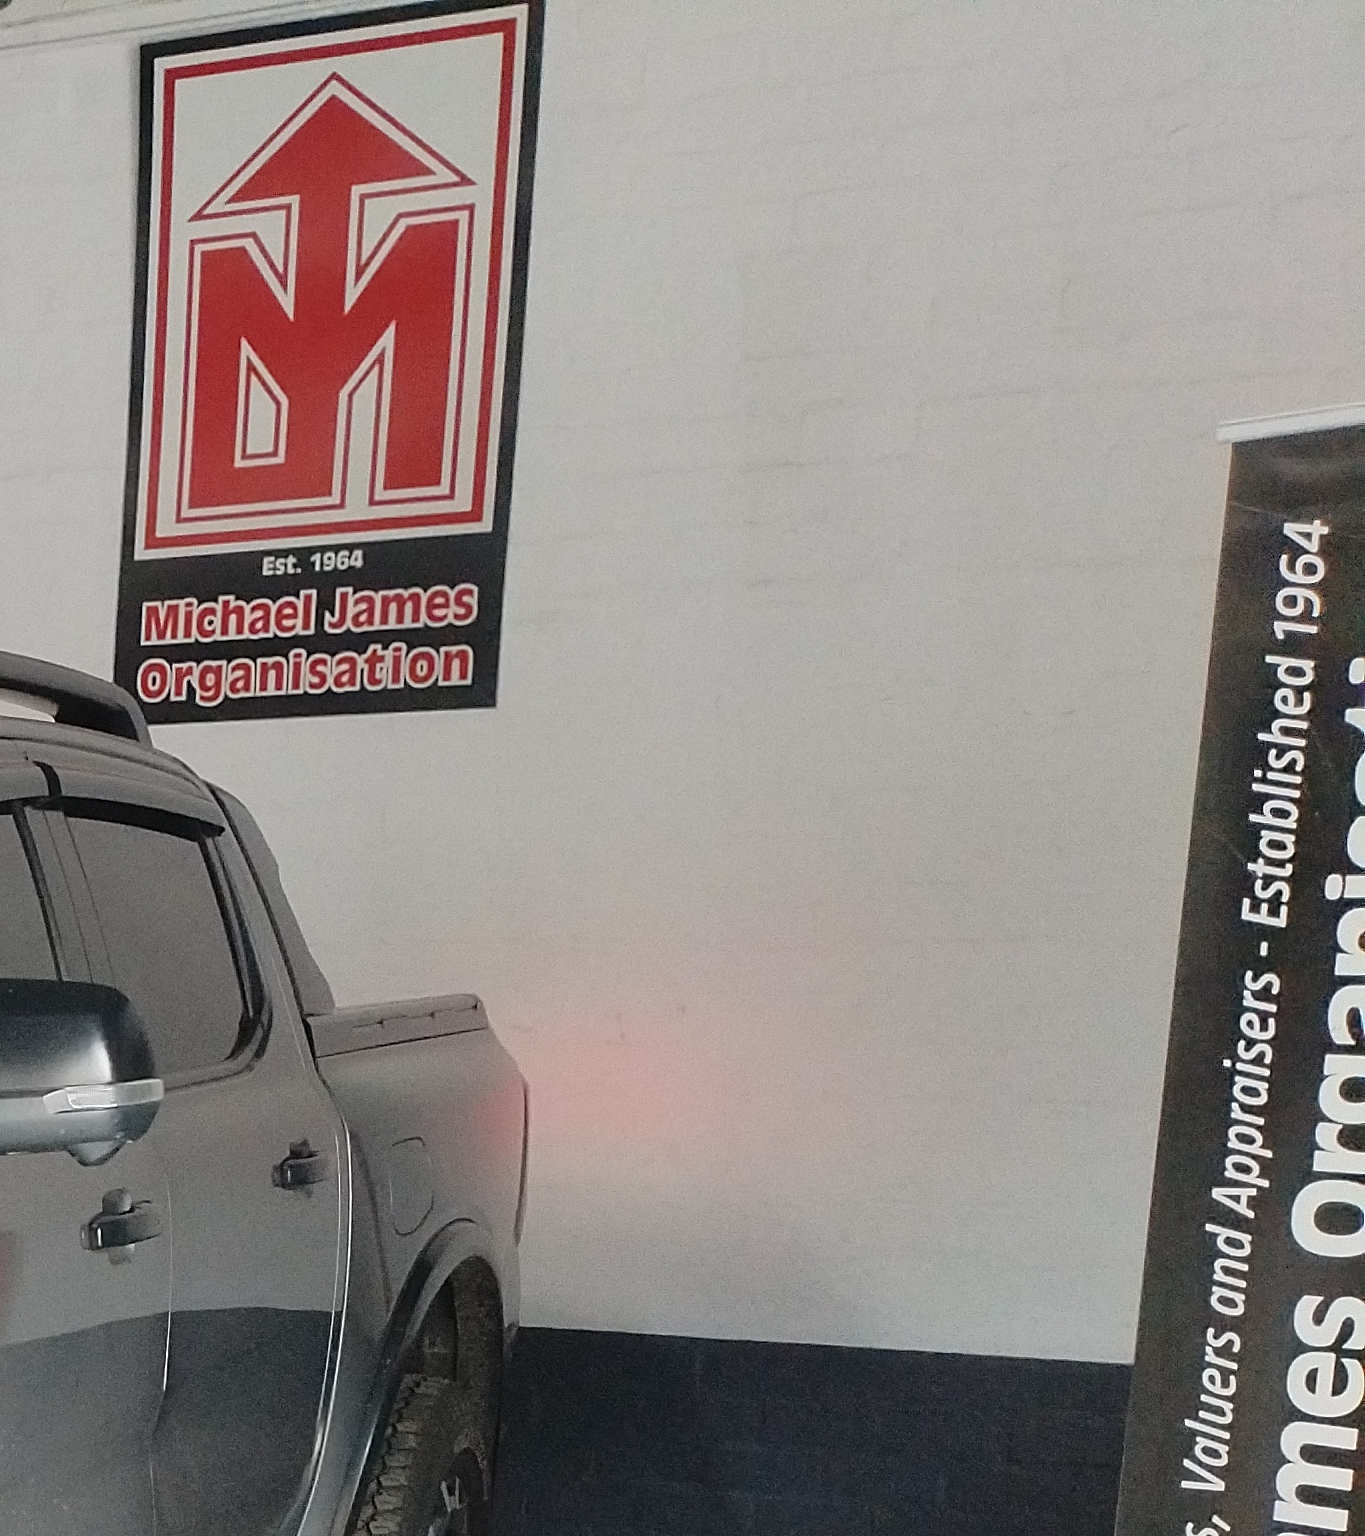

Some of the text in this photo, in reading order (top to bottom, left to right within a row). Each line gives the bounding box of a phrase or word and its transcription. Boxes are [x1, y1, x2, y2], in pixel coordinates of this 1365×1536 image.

[141, 584, 478, 645] Michael James
[262, 550, 364, 576] Est. 1964
[1272, 519, 1330, 640] 1964
[137, 643, 473, 706] Organisation
[1241, 655, 1316, 929] Established
[1211, 970, 1281, 1219] Appraisers
[1205, 1223, 1253, 1316] and
[1180, 1326, 1241, 1493] Valuers
